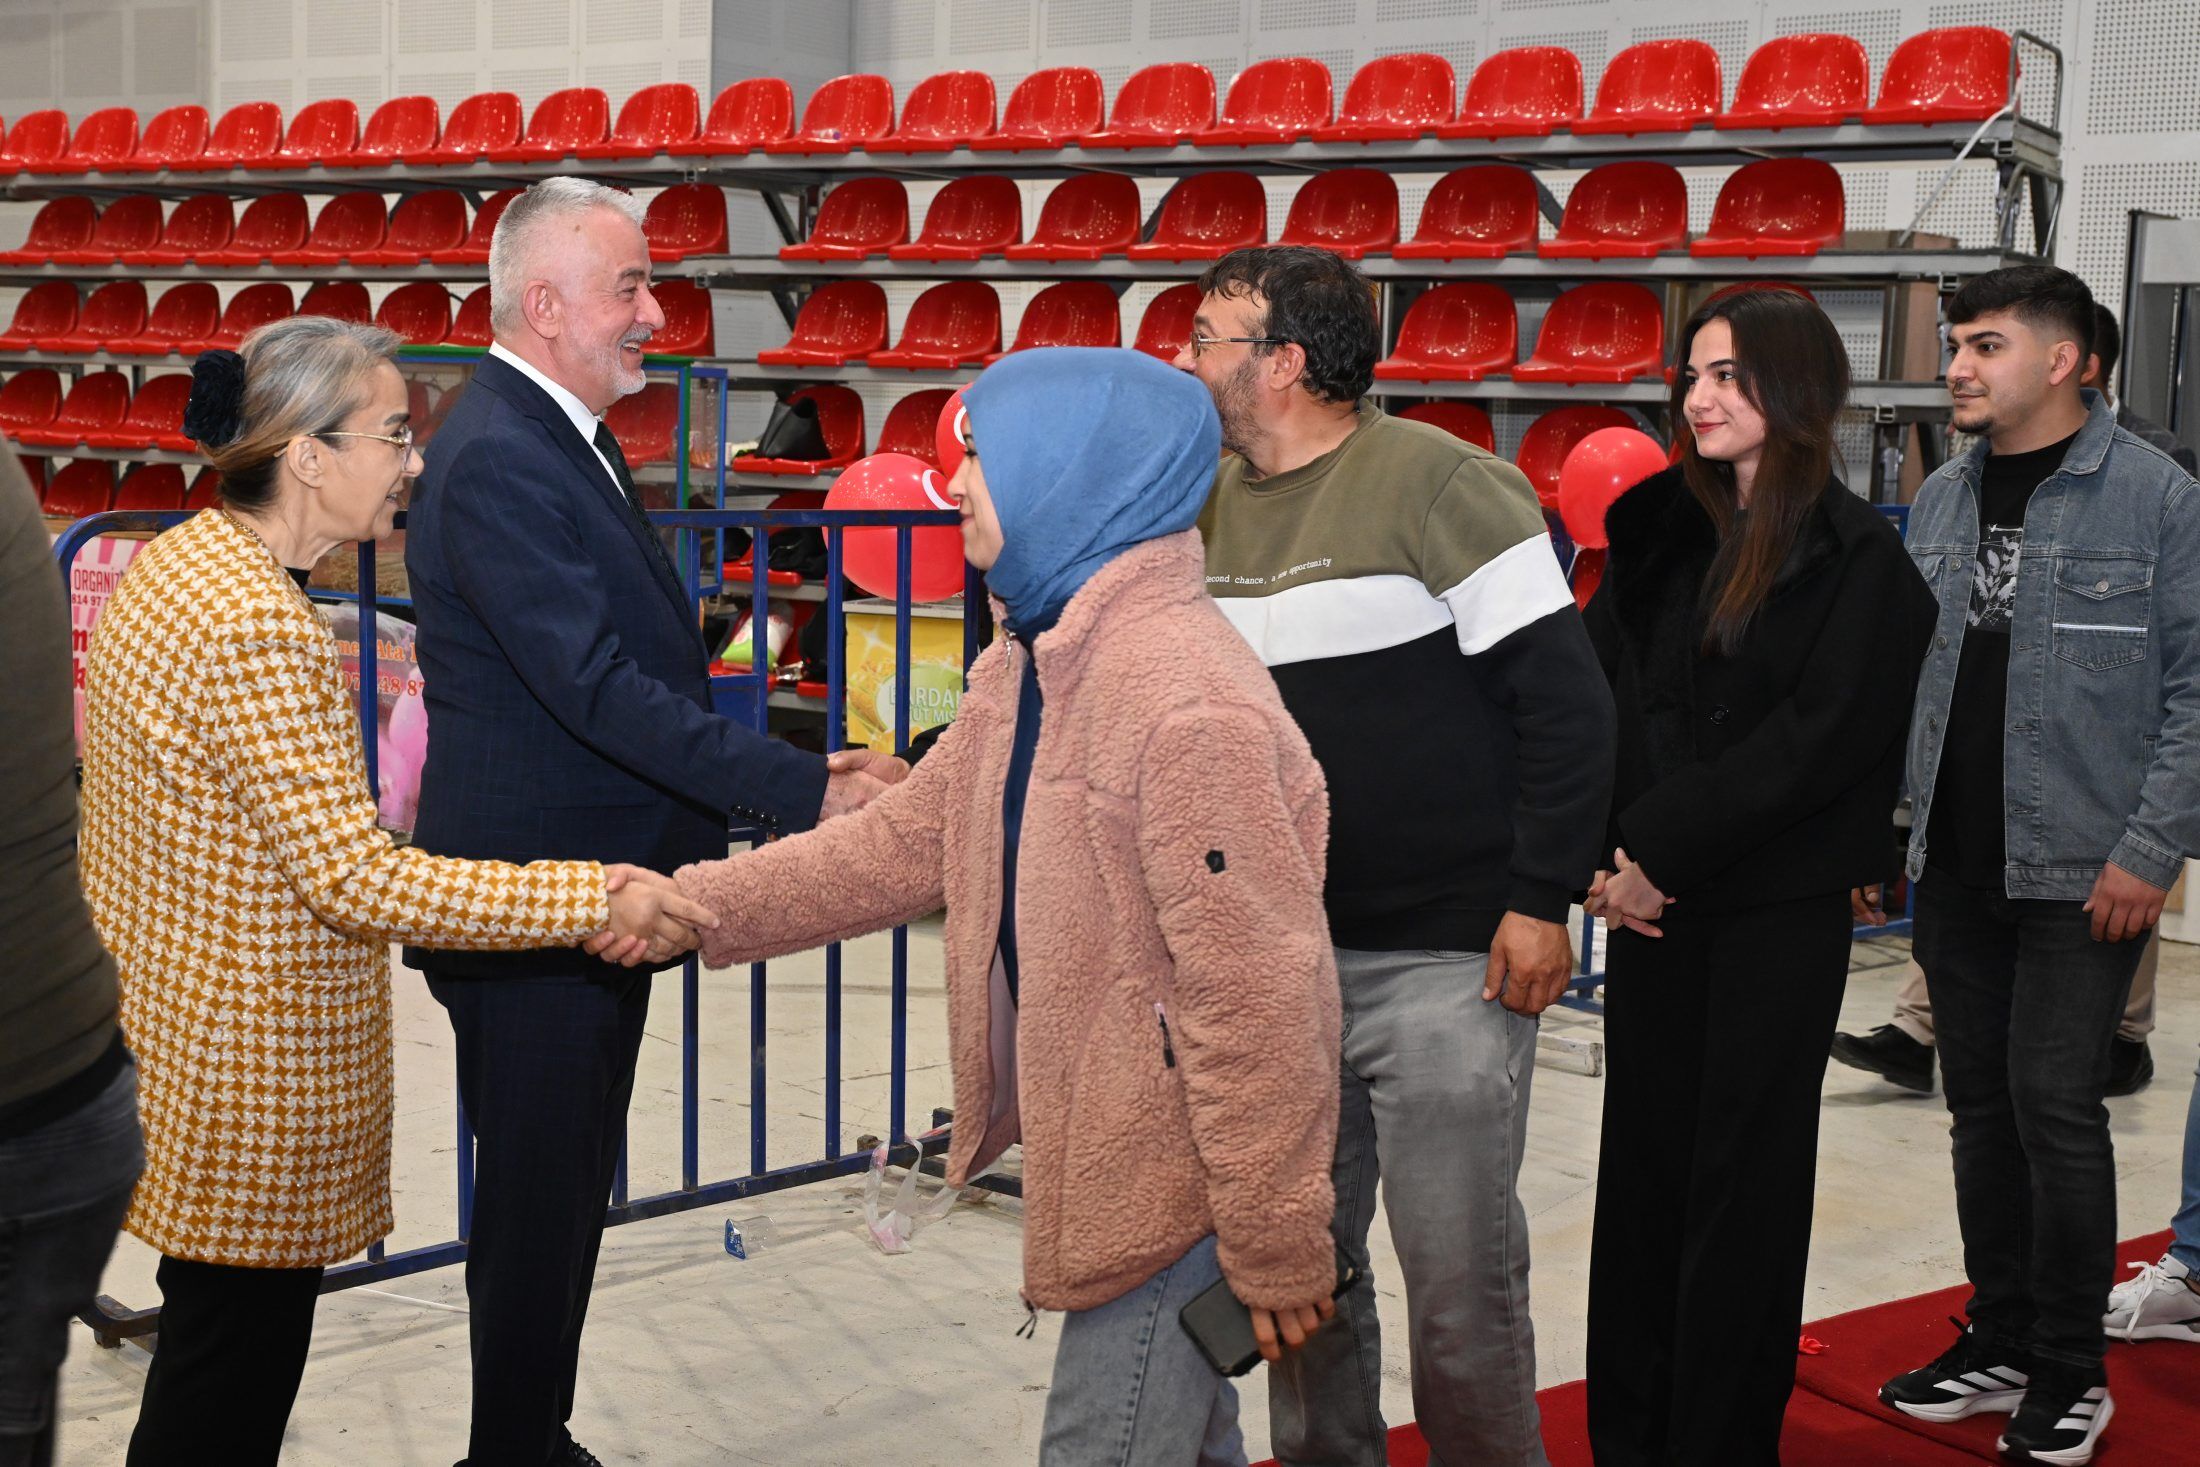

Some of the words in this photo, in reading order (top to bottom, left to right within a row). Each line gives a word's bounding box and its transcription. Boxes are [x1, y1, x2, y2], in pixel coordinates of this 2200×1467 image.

[74, 567, 120, 596] ORGANİZ
[1205, 575, 1230, 583] second
[1234, 575, 1267, 585] chance,
[1289, 557, 1332, 575] opportunity
[379, 675, 402, 696] 48
[933, 709, 956, 724] MIS
